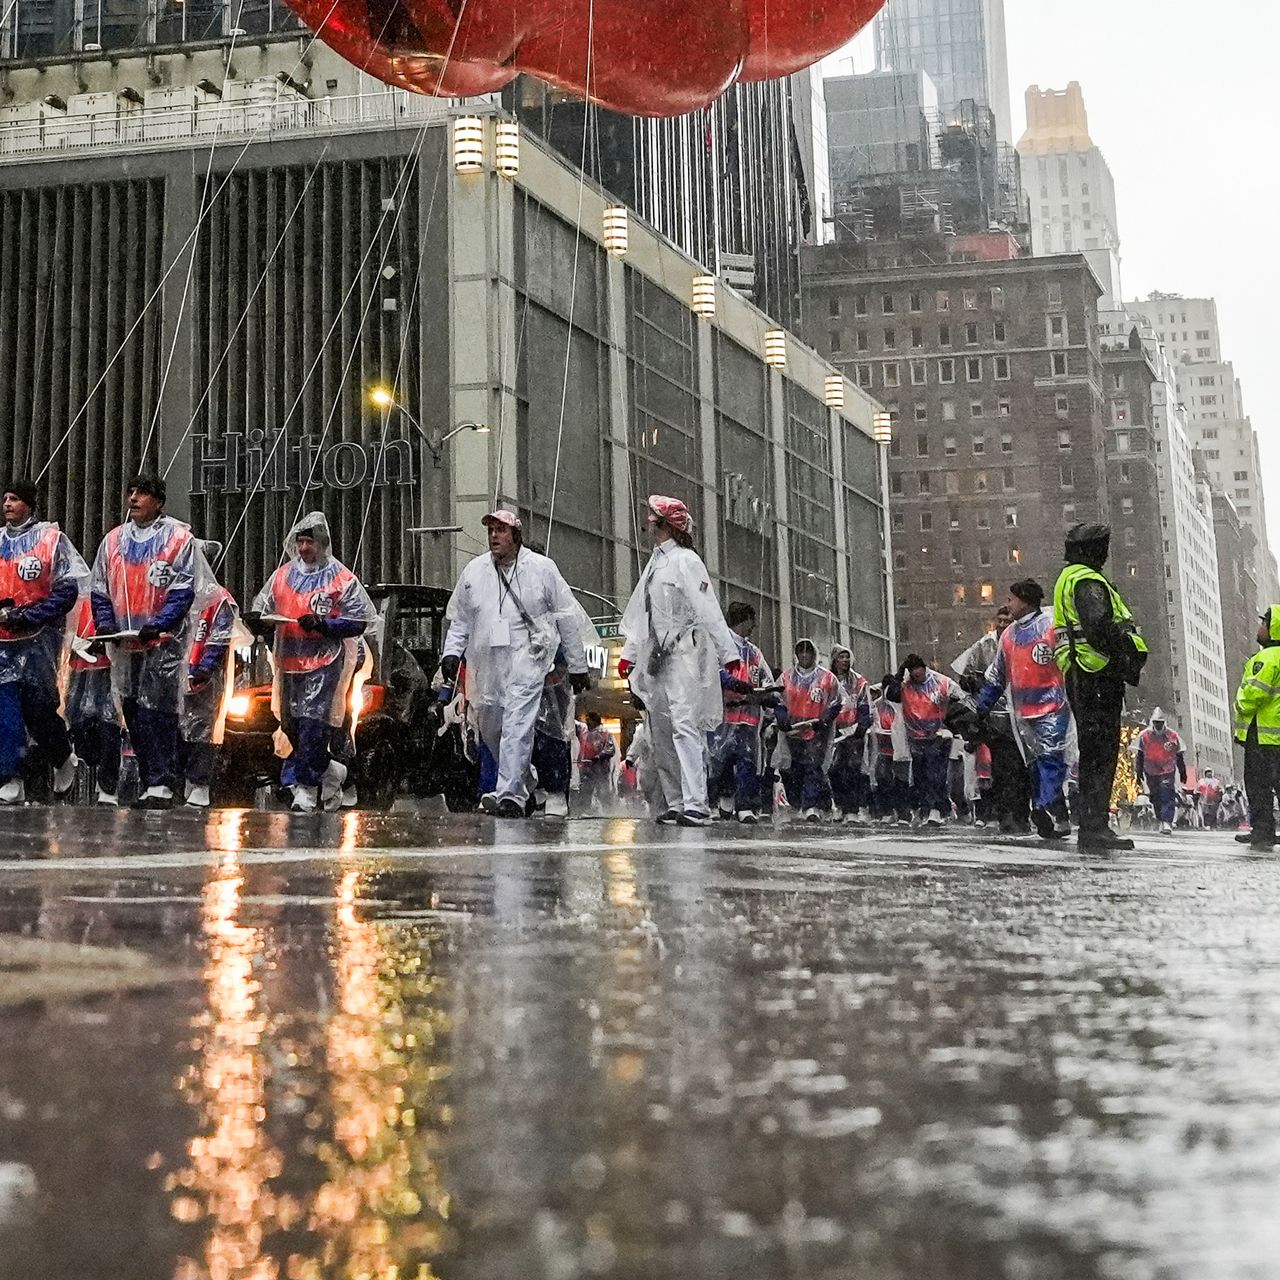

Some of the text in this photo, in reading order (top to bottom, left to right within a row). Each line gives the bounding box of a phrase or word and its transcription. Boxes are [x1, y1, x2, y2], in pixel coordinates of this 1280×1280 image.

[189, 427, 417, 496] Hilton
[19, 556, 41, 580] 悟
[609, 626, 617, 636] 53
